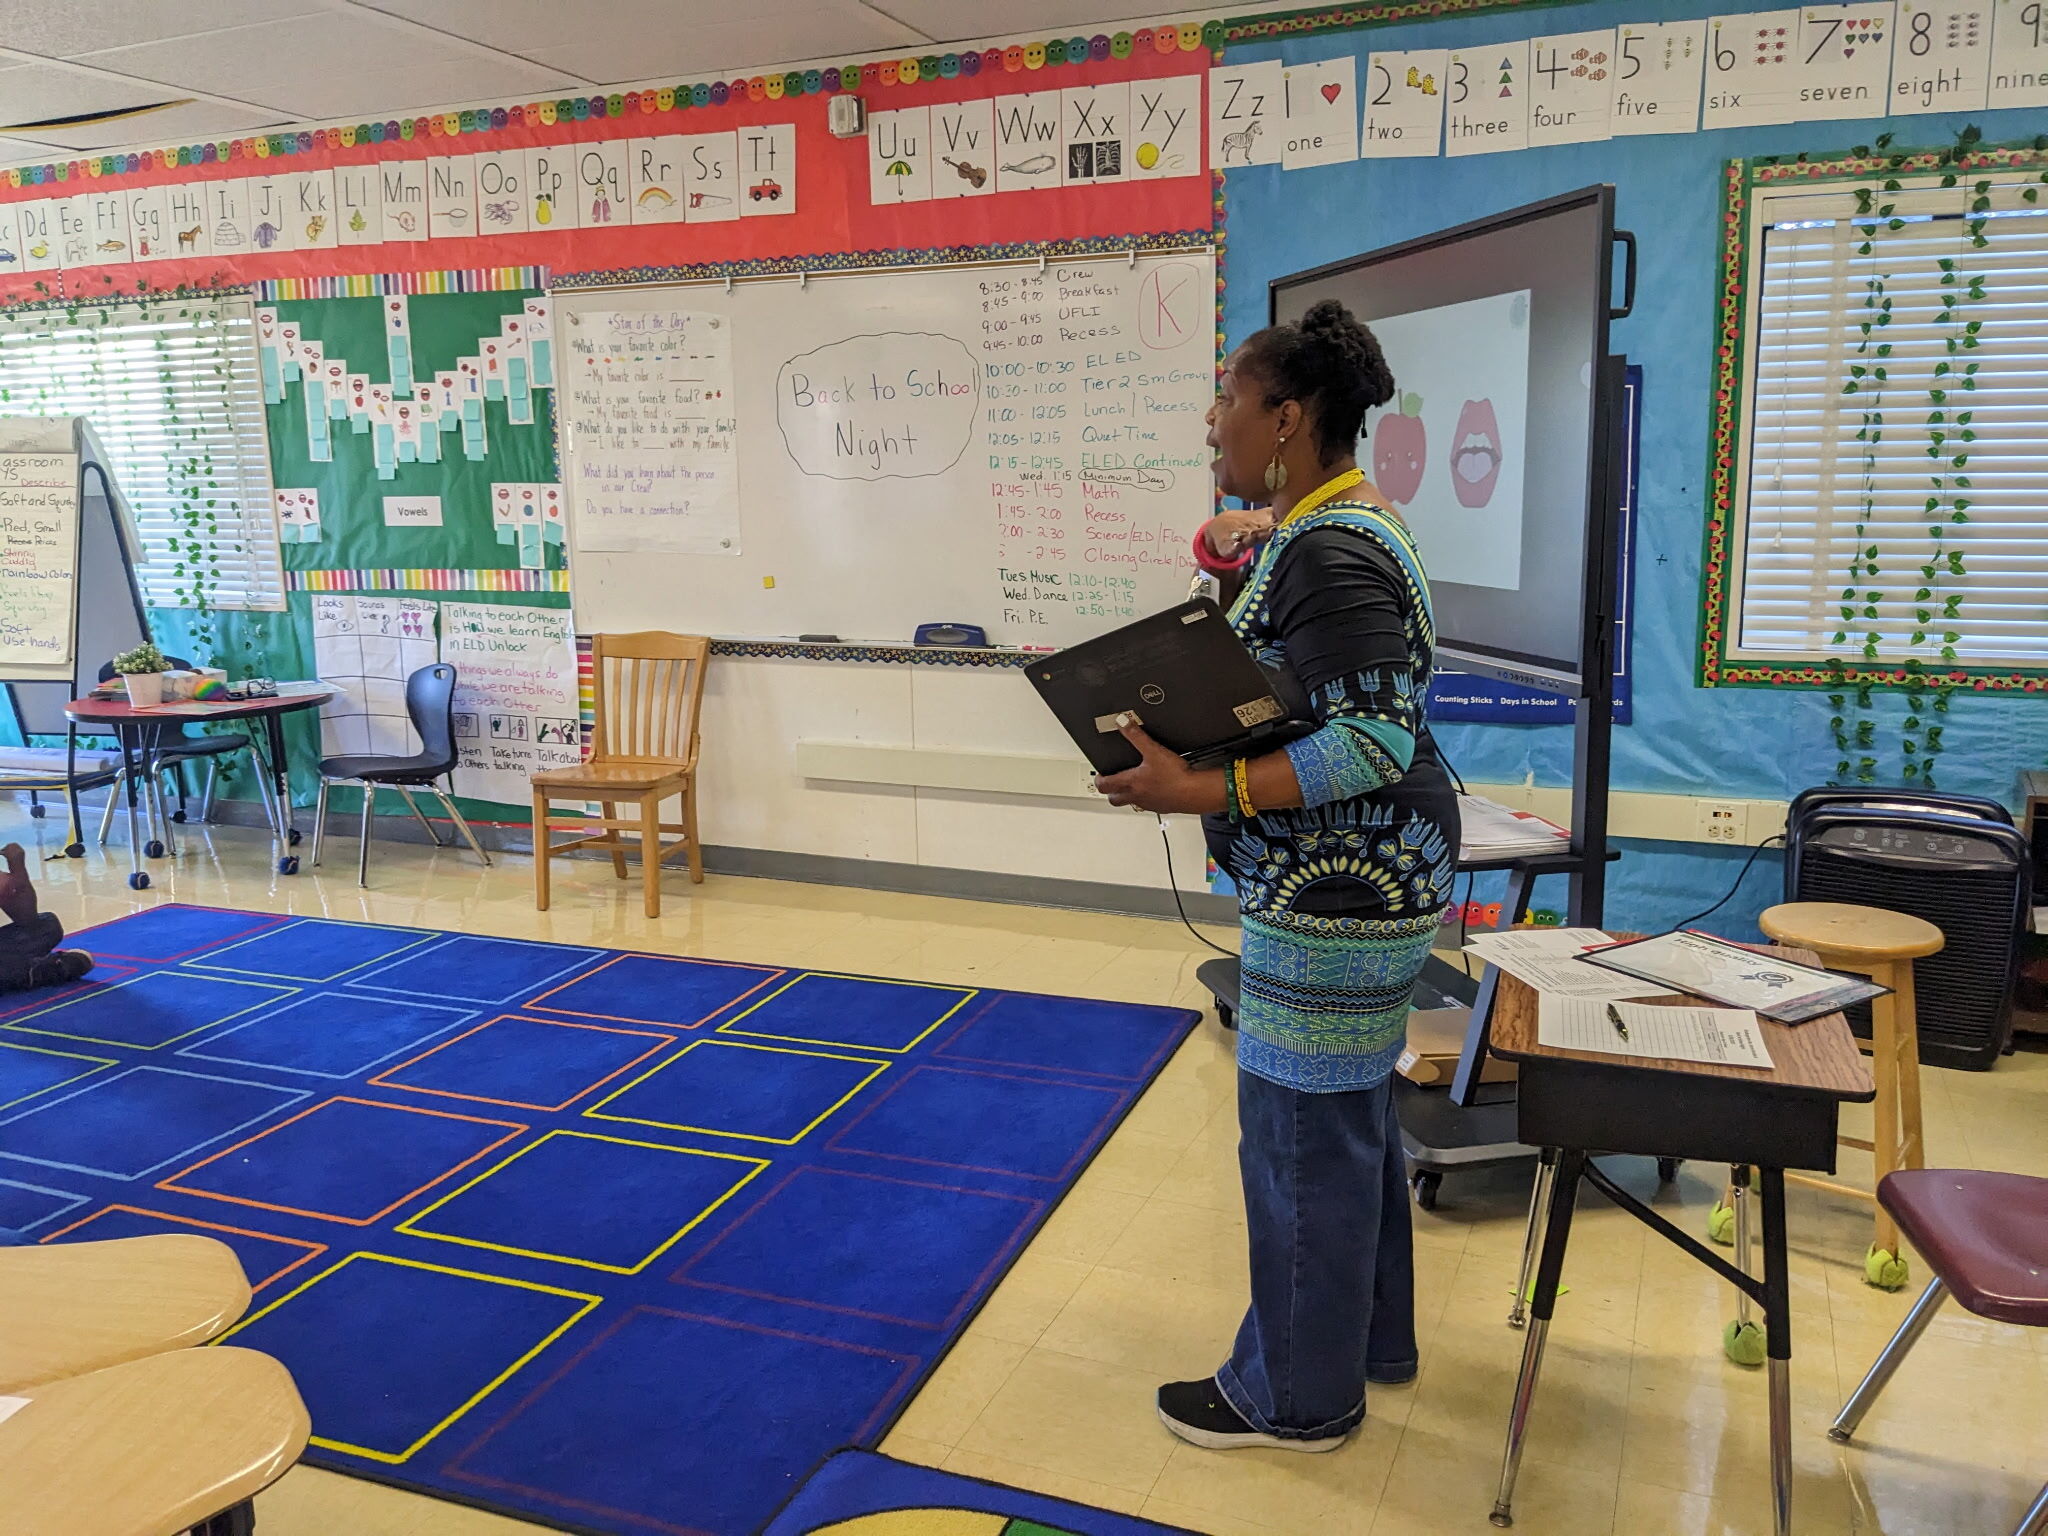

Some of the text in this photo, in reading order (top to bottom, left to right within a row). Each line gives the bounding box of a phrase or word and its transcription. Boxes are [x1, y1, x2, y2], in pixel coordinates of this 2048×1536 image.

[1910, 13, 1931, 56] 8
[2021, 3, 2040, 47] 9
[1714, 29, 1735, 71] 6
[1807, 19, 1842, 64] 7
[1536, 46, 1568, 90] 4
[1622, 37, 1644, 79] 5
[1372, 65, 1393, 105] 2
[1452, 62, 1469, 103] 3
[1800, 83, 1868, 102] seven
[1898, 67, 1962, 107] eight
[1996, 70, 2048, 89] nine
[1222, 79, 1263, 119] Zz
[1617, 96, 1657, 116] five
[1709, 91, 1740, 109] six
[998, 106, 1056, 144] Ww
[1074, 99, 1115, 138] Xx
[1141, 93, 1185, 152] Yy
[1452, 117, 1508, 137] three
[1534, 106, 1577, 128] four
[879, 122, 916, 159] Uu
[943, 116, 979, 151] Vv
[1288, 134, 1323, 151] one
[1368, 123, 1403, 141] two
[642, 150, 671, 182] Rr
[693, 147, 722, 180] Ss
[748, 137, 776, 171] Tt
[384, 171, 421, 204] Mm
[435, 166, 463, 197] Nn
[481, 163, 517, 194] Oo
[538, 159, 561, 207] Pp
[581, 153, 625, 202] Qq
[172, 193, 201, 223] Hh
[219, 190, 234, 219] Ii
[261, 185, 282, 231] Jj
[301, 181, 326, 212] Kk
[25, 208, 47, 237] Dd
[60, 207, 83, 234] Ee
[97, 201, 116, 230] Ff
[133, 198, 159, 241] Gg
[1057, 269, 1093, 282] Crew
[1060, 287, 1119, 301] Breakfast
[1155, 272, 1187, 337] K
[1059, 307, 1100, 320] UFLI
[1060, 326, 1120, 341] Recess
[792, 368, 977, 407] Back to School
[1081, 379, 1115, 393] Tier
[1119, 377, 1129, 388] 2
[1085, 402, 1125, 417] Lunch
[1144, 396, 1198, 412] Recess
[837, 420, 917, 470] Night
[1124, 426, 1158, 441] Time
[1134, 453, 1203, 469] Continued
[1053, 471, 1071, 481] 1:15
[1137, 470, 1165, 488] Day
[1083, 482, 1119, 499] Math
[398, 506, 427, 517] Vowels
[1085, 504, 1127, 522] Recess
[1084, 548, 1137, 571] Closing
[318, 597, 344, 608] Looks
[1034, 587, 1068, 601] Dance
[319, 611, 337, 620] Like
[444, 604, 481, 619] Talking
[528, 612, 564, 624] Other
[509, 625, 540, 637] learn
[489, 641, 527, 652] Unlock
[1435, 695, 1492, 705] Counting Sticks
[1500, 698, 1519, 706] Days
[1531, 698, 1557, 706] School
